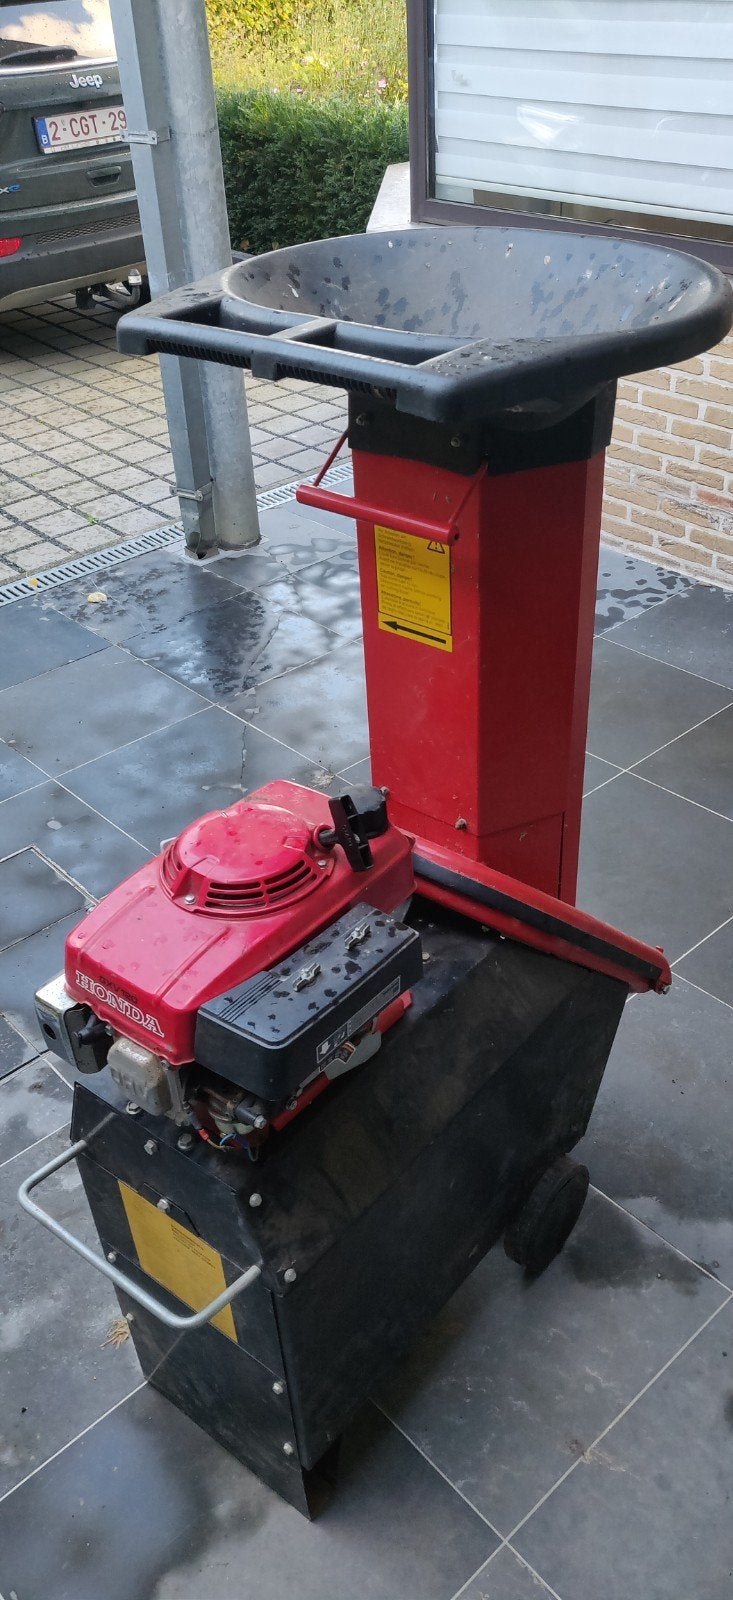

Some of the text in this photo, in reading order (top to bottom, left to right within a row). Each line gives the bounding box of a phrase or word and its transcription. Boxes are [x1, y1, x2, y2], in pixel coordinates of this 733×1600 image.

[69, 74, 103, 89] Jeep
[41, 134, 49, 145] B
[75, 970, 165, 1038] HONDA
